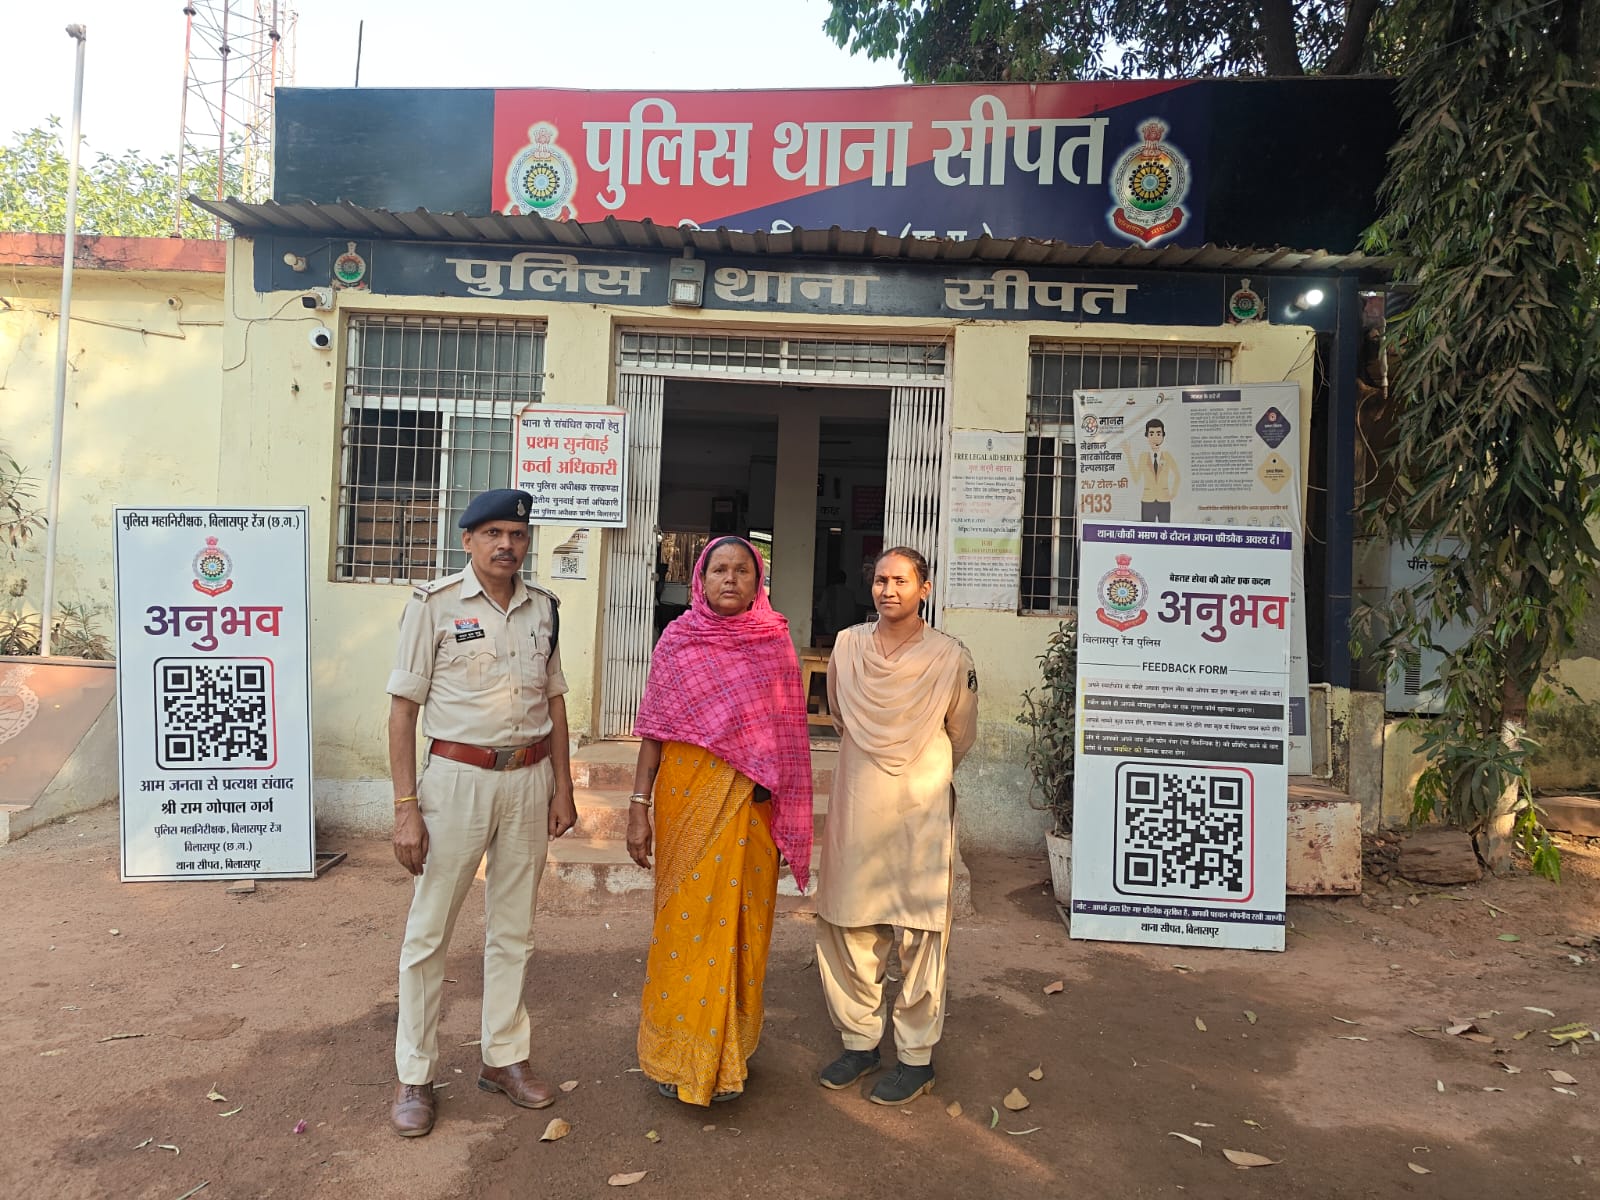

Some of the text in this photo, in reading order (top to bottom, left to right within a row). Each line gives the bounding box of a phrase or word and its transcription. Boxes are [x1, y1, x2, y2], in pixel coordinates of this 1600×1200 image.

[582, 95, 1110, 210] पुलिस थाना सीपत
[446, 252, 1138, 315] पुलिस थाना सीपत
[522, 419, 540, 428] थाना
[554, 417, 582, 429] संबंधित
[608, 418, 619, 433] हेतु
[1099, 416, 1124, 425] मानस
[526, 434, 609, 455] प्रथम सुनवाई
[1080, 440, 1107, 450] नेशनल
[954, 452, 968, 461] FREE
[970, 453, 987, 461] LEGAL
[990, 453, 999, 461] AID
[1080, 450, 1122, 461] नारकोटिक्स
[522, 456, 617, 475] कर्ता अधिकारी
[1080, 463, 1115, 473] हेल्पलाइन
[520, 481, 535, 489] नगर
[536, 480, 556, 492] पुलिस
[560, 481, 587, 492] अधीक्षक
[1097, 477, 1128, 489] टोल-फ्री
[1081, 493, 1112, 513] 1933
[123, 512, 300, 531] पुलिस महानिरीक्षक, बिलासपुर रेंज (छ.ग.)
[1097, 528, 1135, 540] थाना/चौकी
[1160, 529, 1168, 541] के
[1169, 530, 1190, 541] दौरान
[1193, 533, 1213, 542] अपना
[1246, 535, 1268, 545] अवश्य
[1169, 572, 1272, 586] बेहतर सेवा की ओर एक कदम
[1158, 590, 1289, 643] अनुभव
[144, 606, 283, 651] अनुभव
[1083, 633, 1161, 649] बिलासपुर रेंज पुलिस
[1142, 661, 1228, 675] FEEDBACK FORM
[140, 774, 294, 792] आम जनता से प्रत्यक्ष संवाद
[161, 797, 273, 814] श्री राम गोपाल गर्ग
[154, 823, 177, 838] पुलिस
[232, 822, 267, 835] बिलासपुर
[269, 821, 282, 833] रेंज
[185, 840, 253, 854] बिलासपुर (छ.ग.)
[176, 858, 261, 871] थाना सीपत, बिलासपुर
[1141, 921, 1219, 938] थाना सीपत, बिलासपुर
